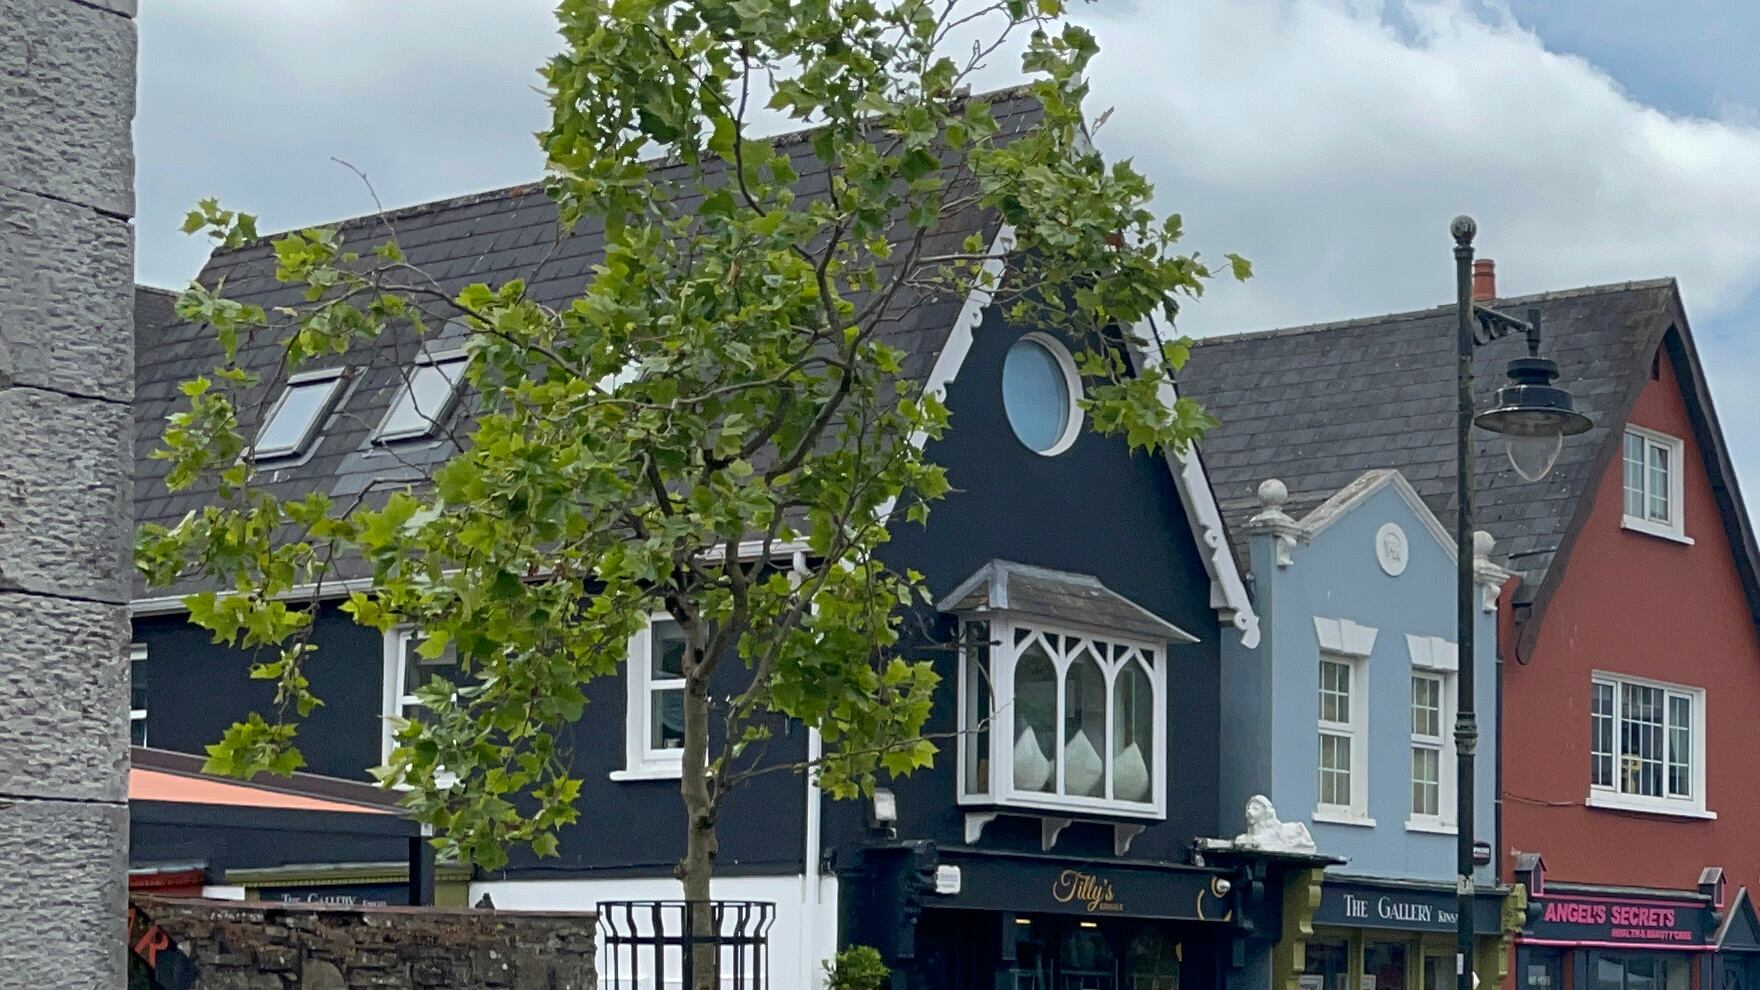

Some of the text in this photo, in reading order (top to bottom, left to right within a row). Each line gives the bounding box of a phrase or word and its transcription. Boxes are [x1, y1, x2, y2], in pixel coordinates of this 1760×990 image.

[1053, 869, 1114, 912] Tilly's
[1343, 894, 1368, 918] THE
[1378, 896, 1433, 922] GALLERY
[1545, 902, 1675, 927] ANGEL'S SECRETS
